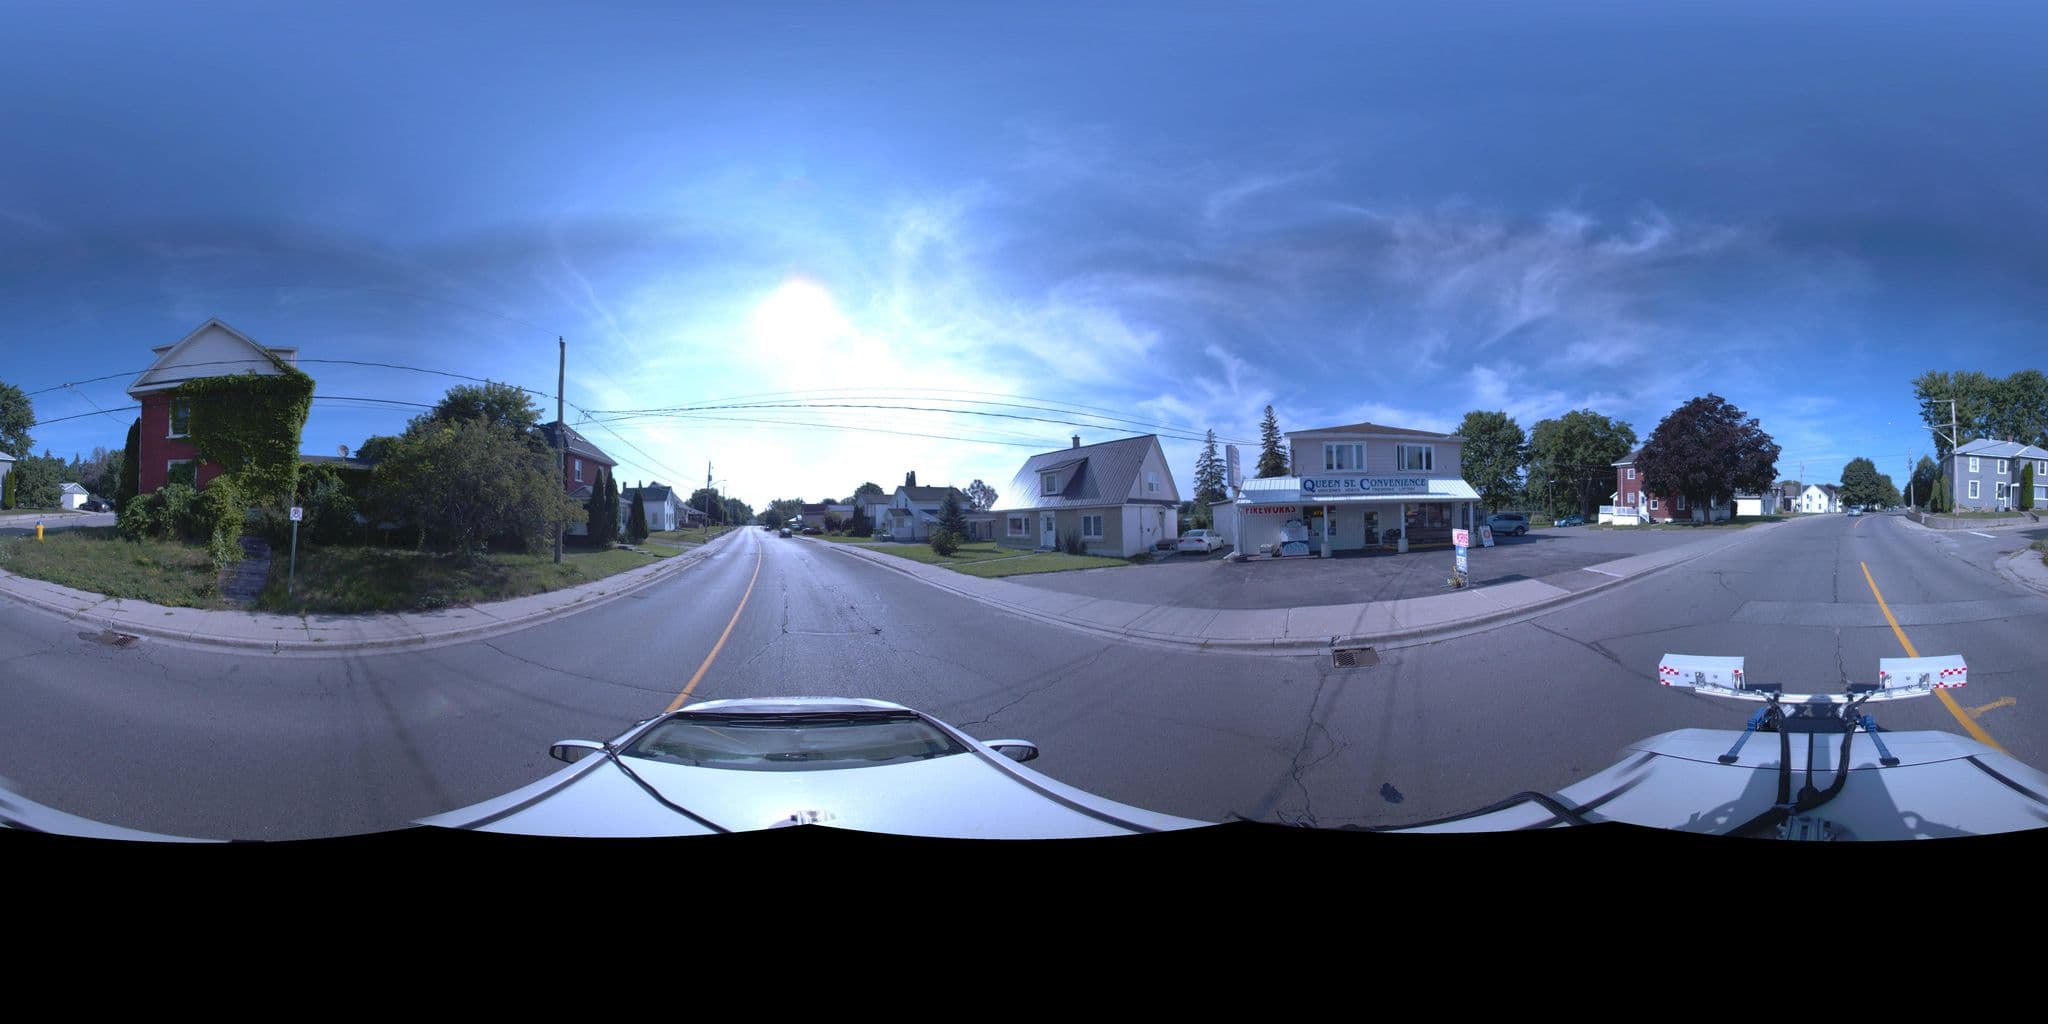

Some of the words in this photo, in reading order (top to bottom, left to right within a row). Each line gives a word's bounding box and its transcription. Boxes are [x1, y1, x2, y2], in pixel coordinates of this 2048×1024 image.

[1303, 479, 1340, 492] QUEEN
[1360, 478, 1426, 490] CONVENIENCE
[1245, 504, 1297, 515] FIREWORKS
